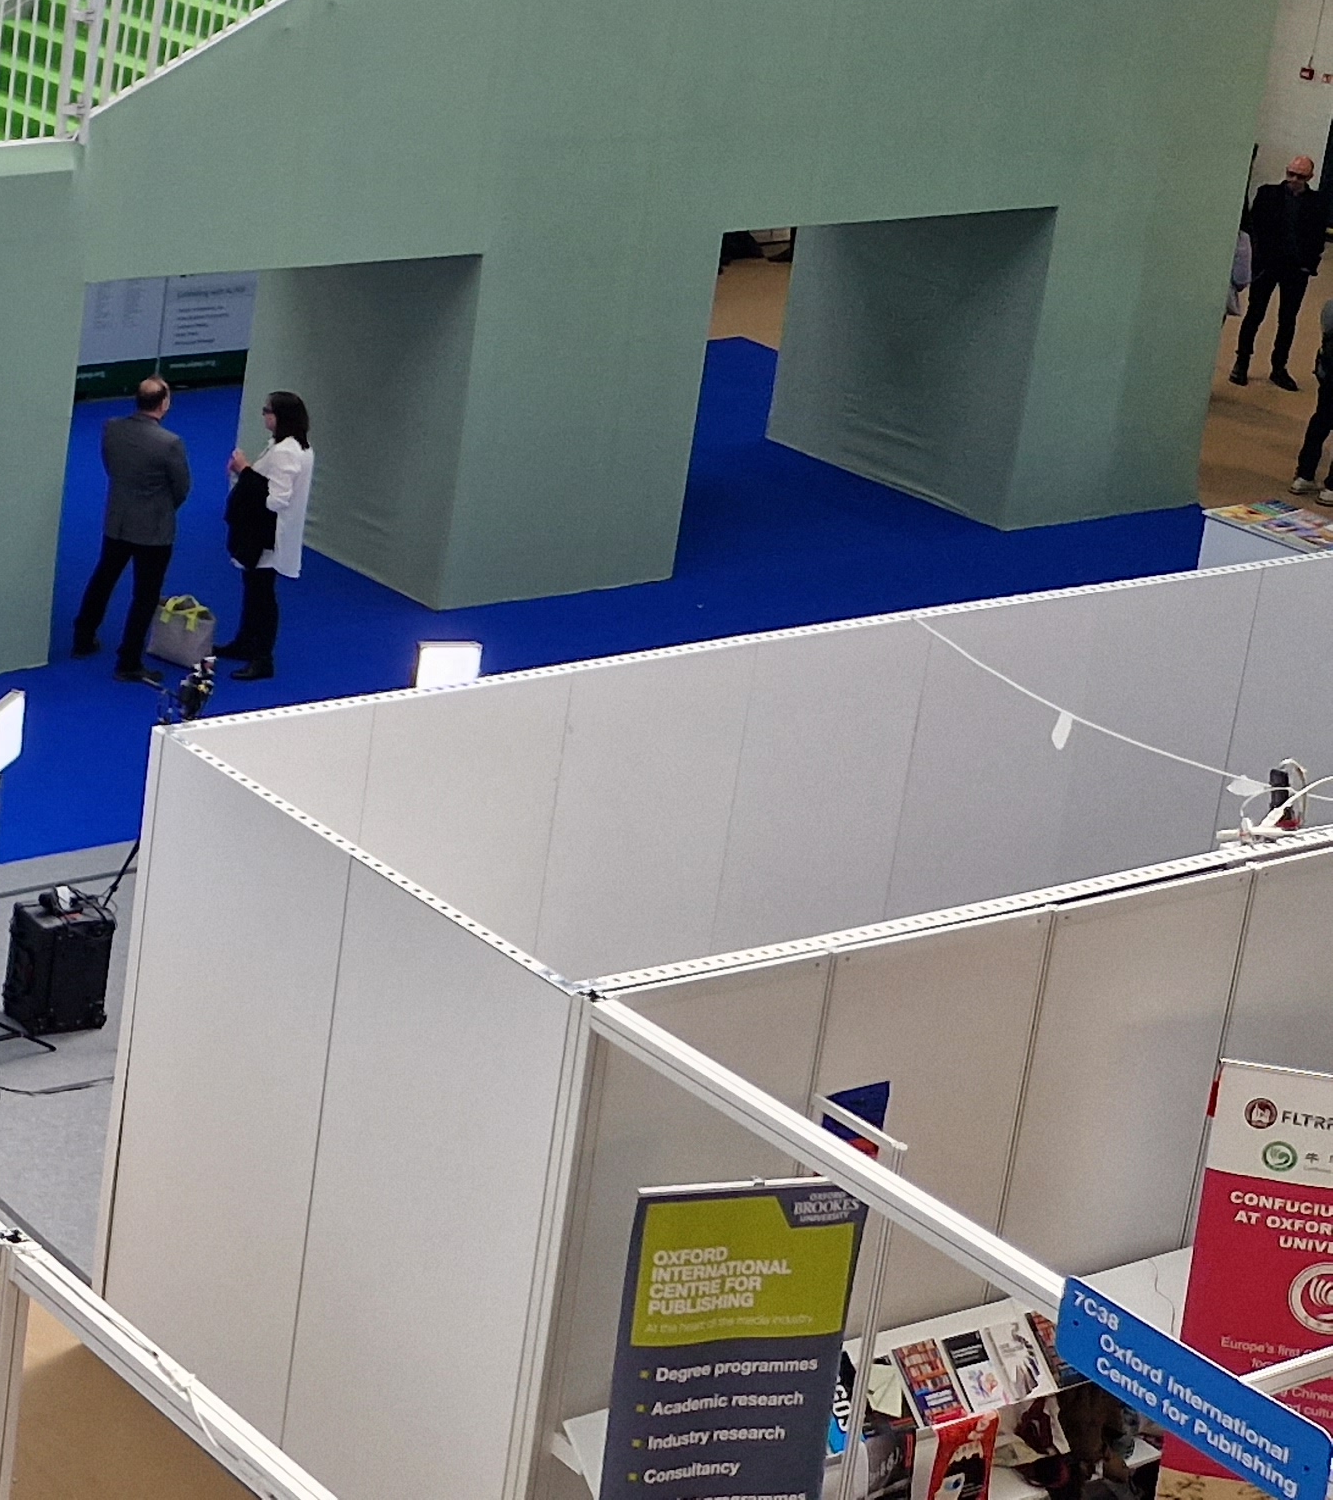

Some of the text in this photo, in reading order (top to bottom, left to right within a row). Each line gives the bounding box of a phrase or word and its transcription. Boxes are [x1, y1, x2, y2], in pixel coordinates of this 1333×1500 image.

[794, 1198, 860, 1216] BROOKES
[799, 1211, 851, 1223] UNIVERSITY
[1234, 1210, 1261, 1225] AT
[653, 1246, 729, 1266] OXFORD
[651, 1258, 792, 1283] INTERNATIONAL
[649, 1275, 762, 1299] CENTRE FOR
[647, 1292, 755, 1316] PUBLISHING
[1073, 1290, 1121, 1332] 7C38
[1220, 1335, 1275, 1355] Europe's
[655, 1357, 819, 1383] Degree programmes
[650, 1390, 804, 1417] Academic research
[1099, 1333, 1291, 1464] Oxford International
[647, 1425, 786, 1451] Industry research
[1096, 1357, 1299, 1499] Centre for Publishing
[643, 1460, 741, 1485] Consultancy
